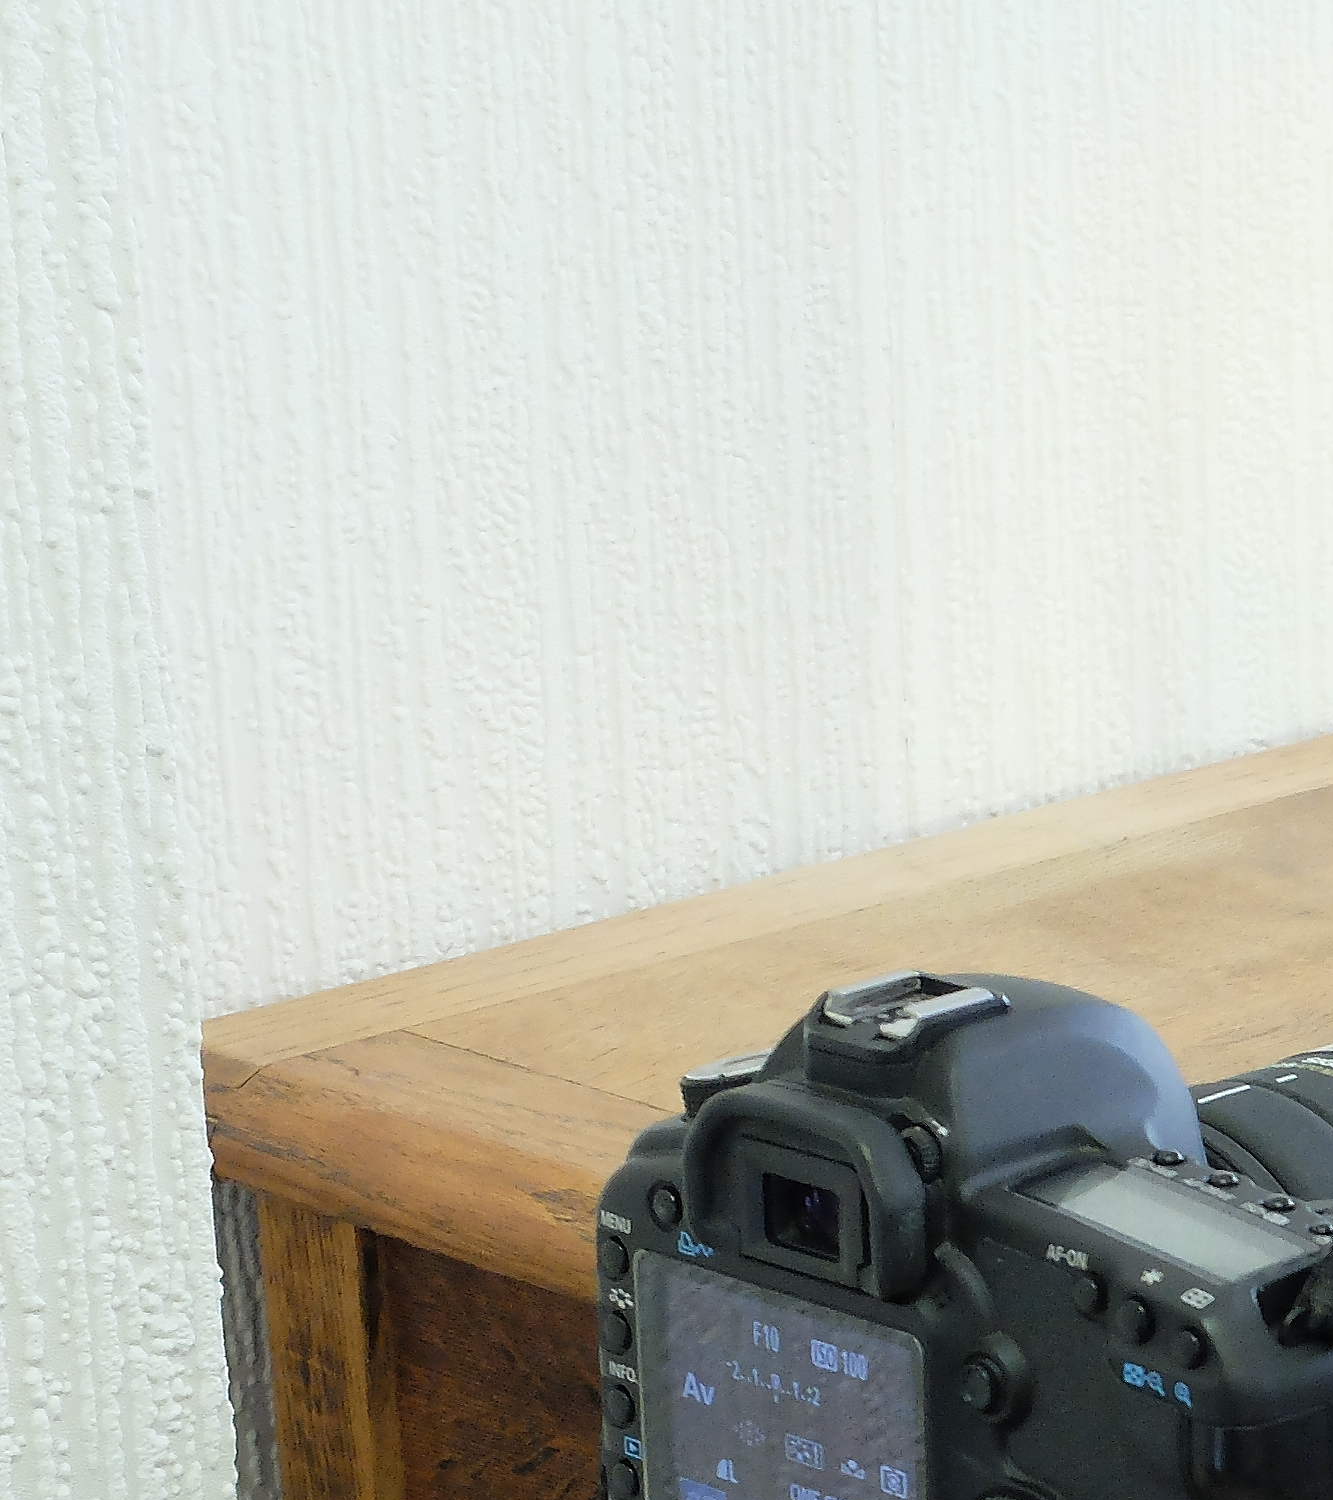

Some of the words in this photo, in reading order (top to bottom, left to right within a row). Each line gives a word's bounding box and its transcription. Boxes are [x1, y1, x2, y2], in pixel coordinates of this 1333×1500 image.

[600, 1209, 633, 1236] MENU
[753, 1320, 780, 1353] F10
[683, 1371, 716, 1406] Av
